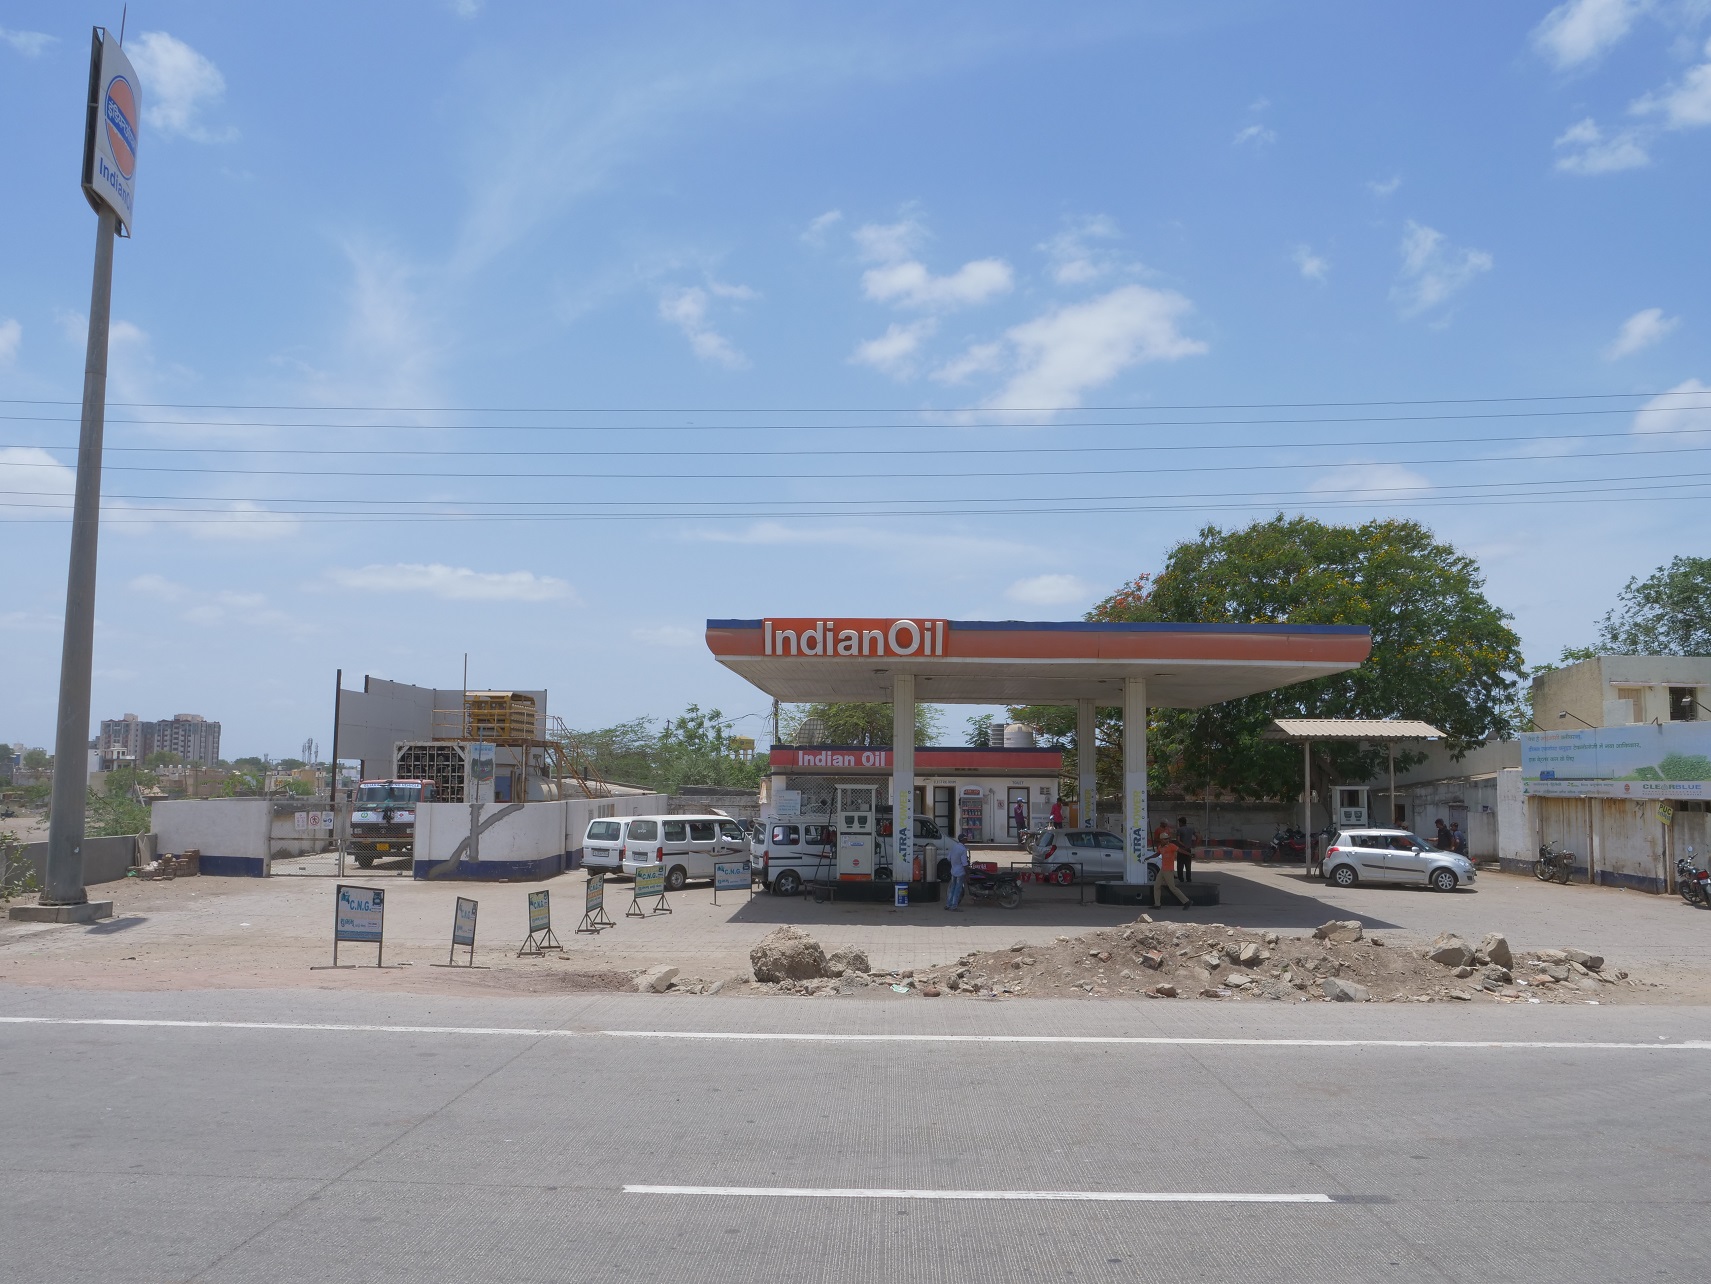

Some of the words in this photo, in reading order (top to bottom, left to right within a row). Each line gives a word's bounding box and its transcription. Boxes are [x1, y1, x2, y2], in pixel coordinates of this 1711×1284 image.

[764, 620, 943, 656] IndianOil
[798, 750, 855, 766] Indian
[861, 751, 886, 766] Oil
[1659, 803, 1672, 816] PUC
[350, 899, 371, 912] C.N.G.
